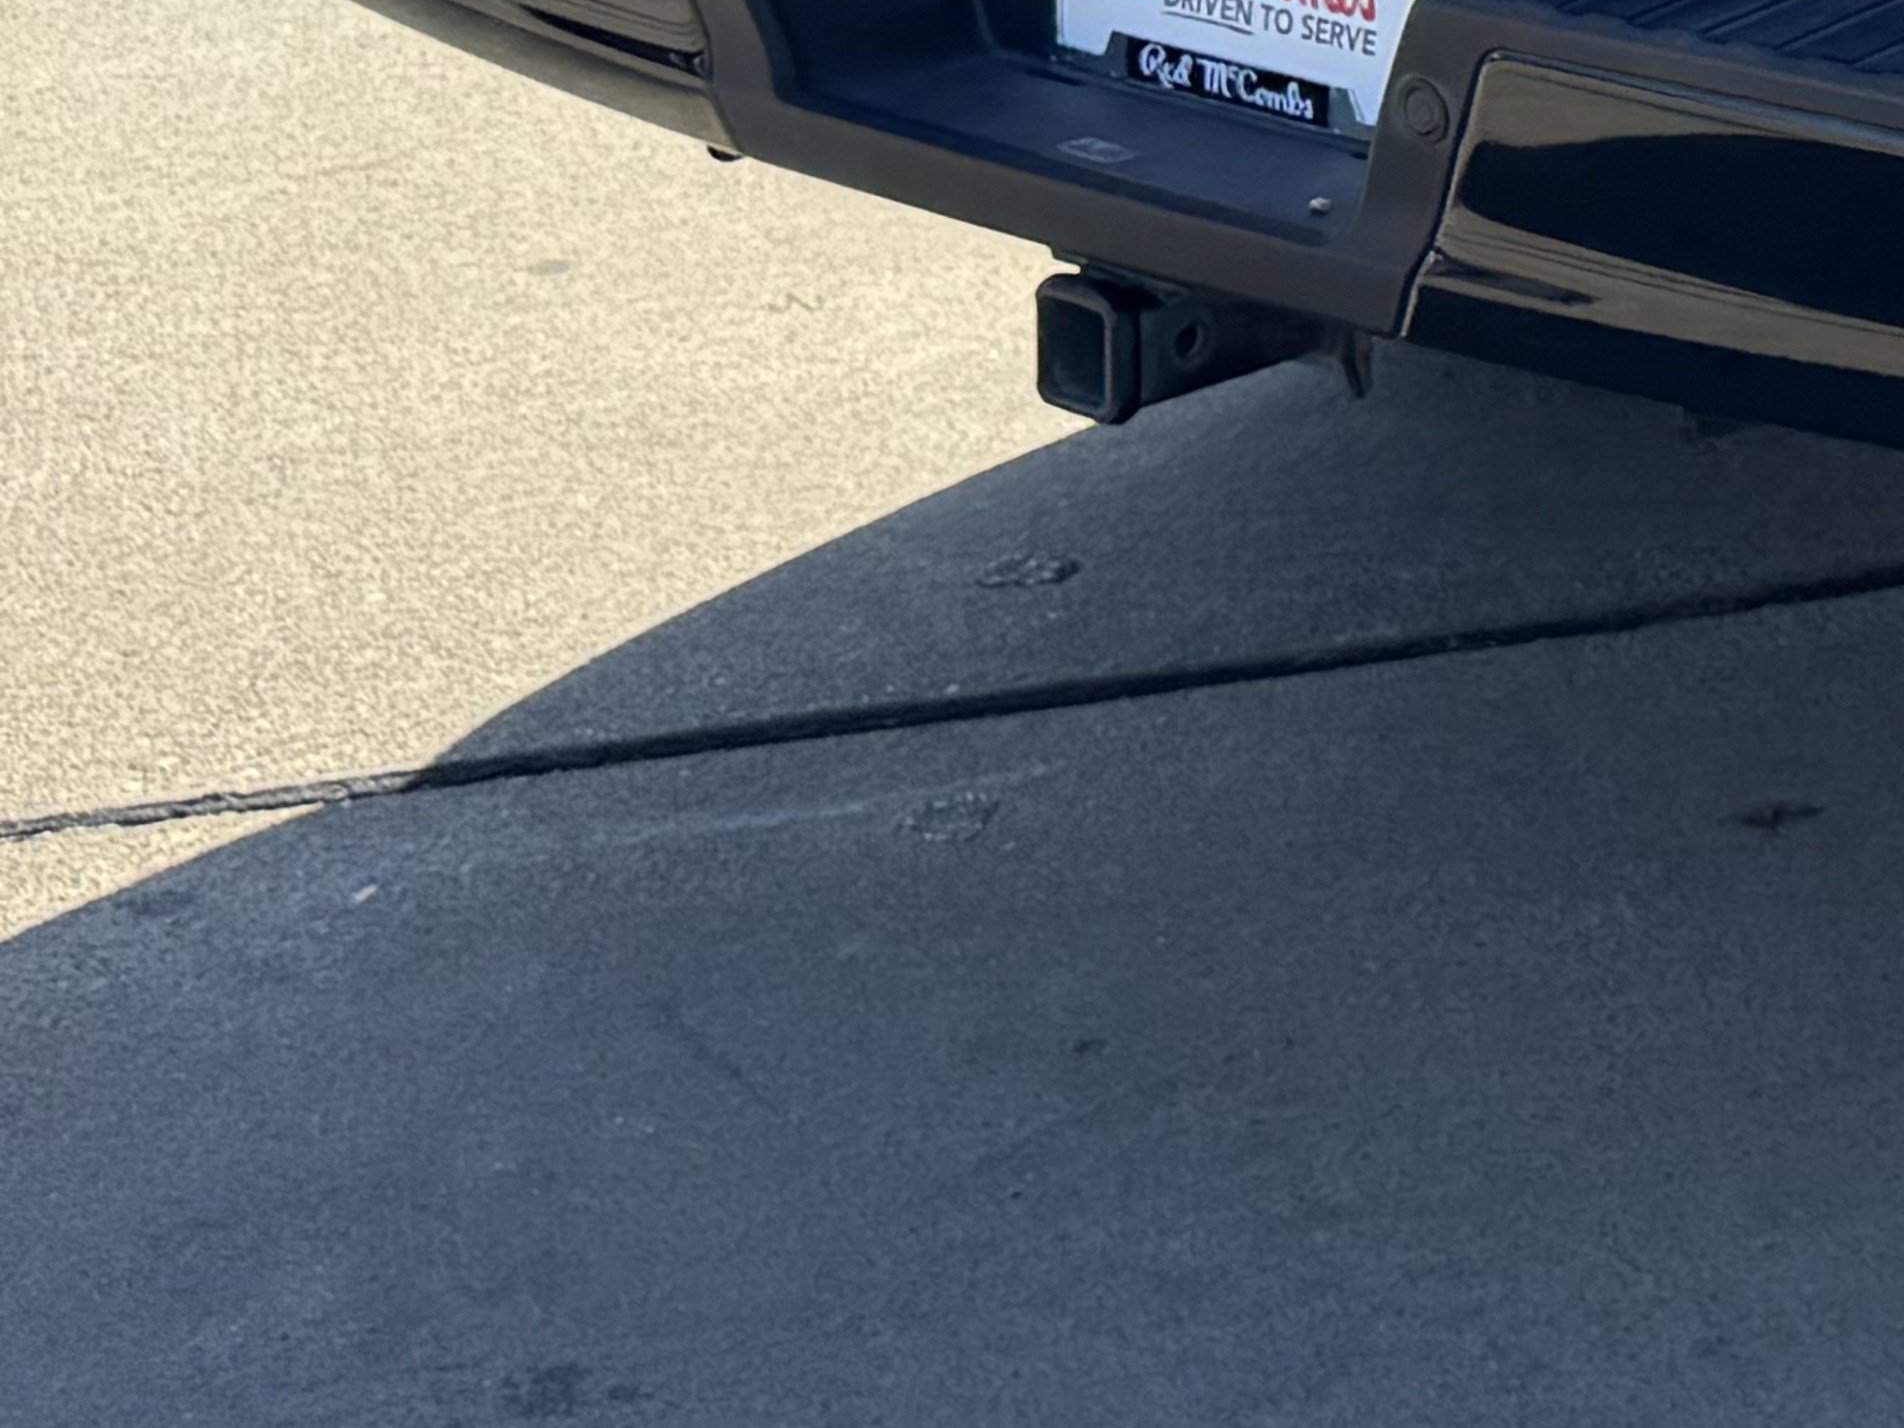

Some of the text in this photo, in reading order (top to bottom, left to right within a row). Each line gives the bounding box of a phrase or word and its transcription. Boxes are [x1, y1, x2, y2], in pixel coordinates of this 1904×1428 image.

[1261, 3, 1294, 36] TO
[1301, 14, 1378, 57] SERVE
[1138, 42, 1315, 121] Red McCombs
